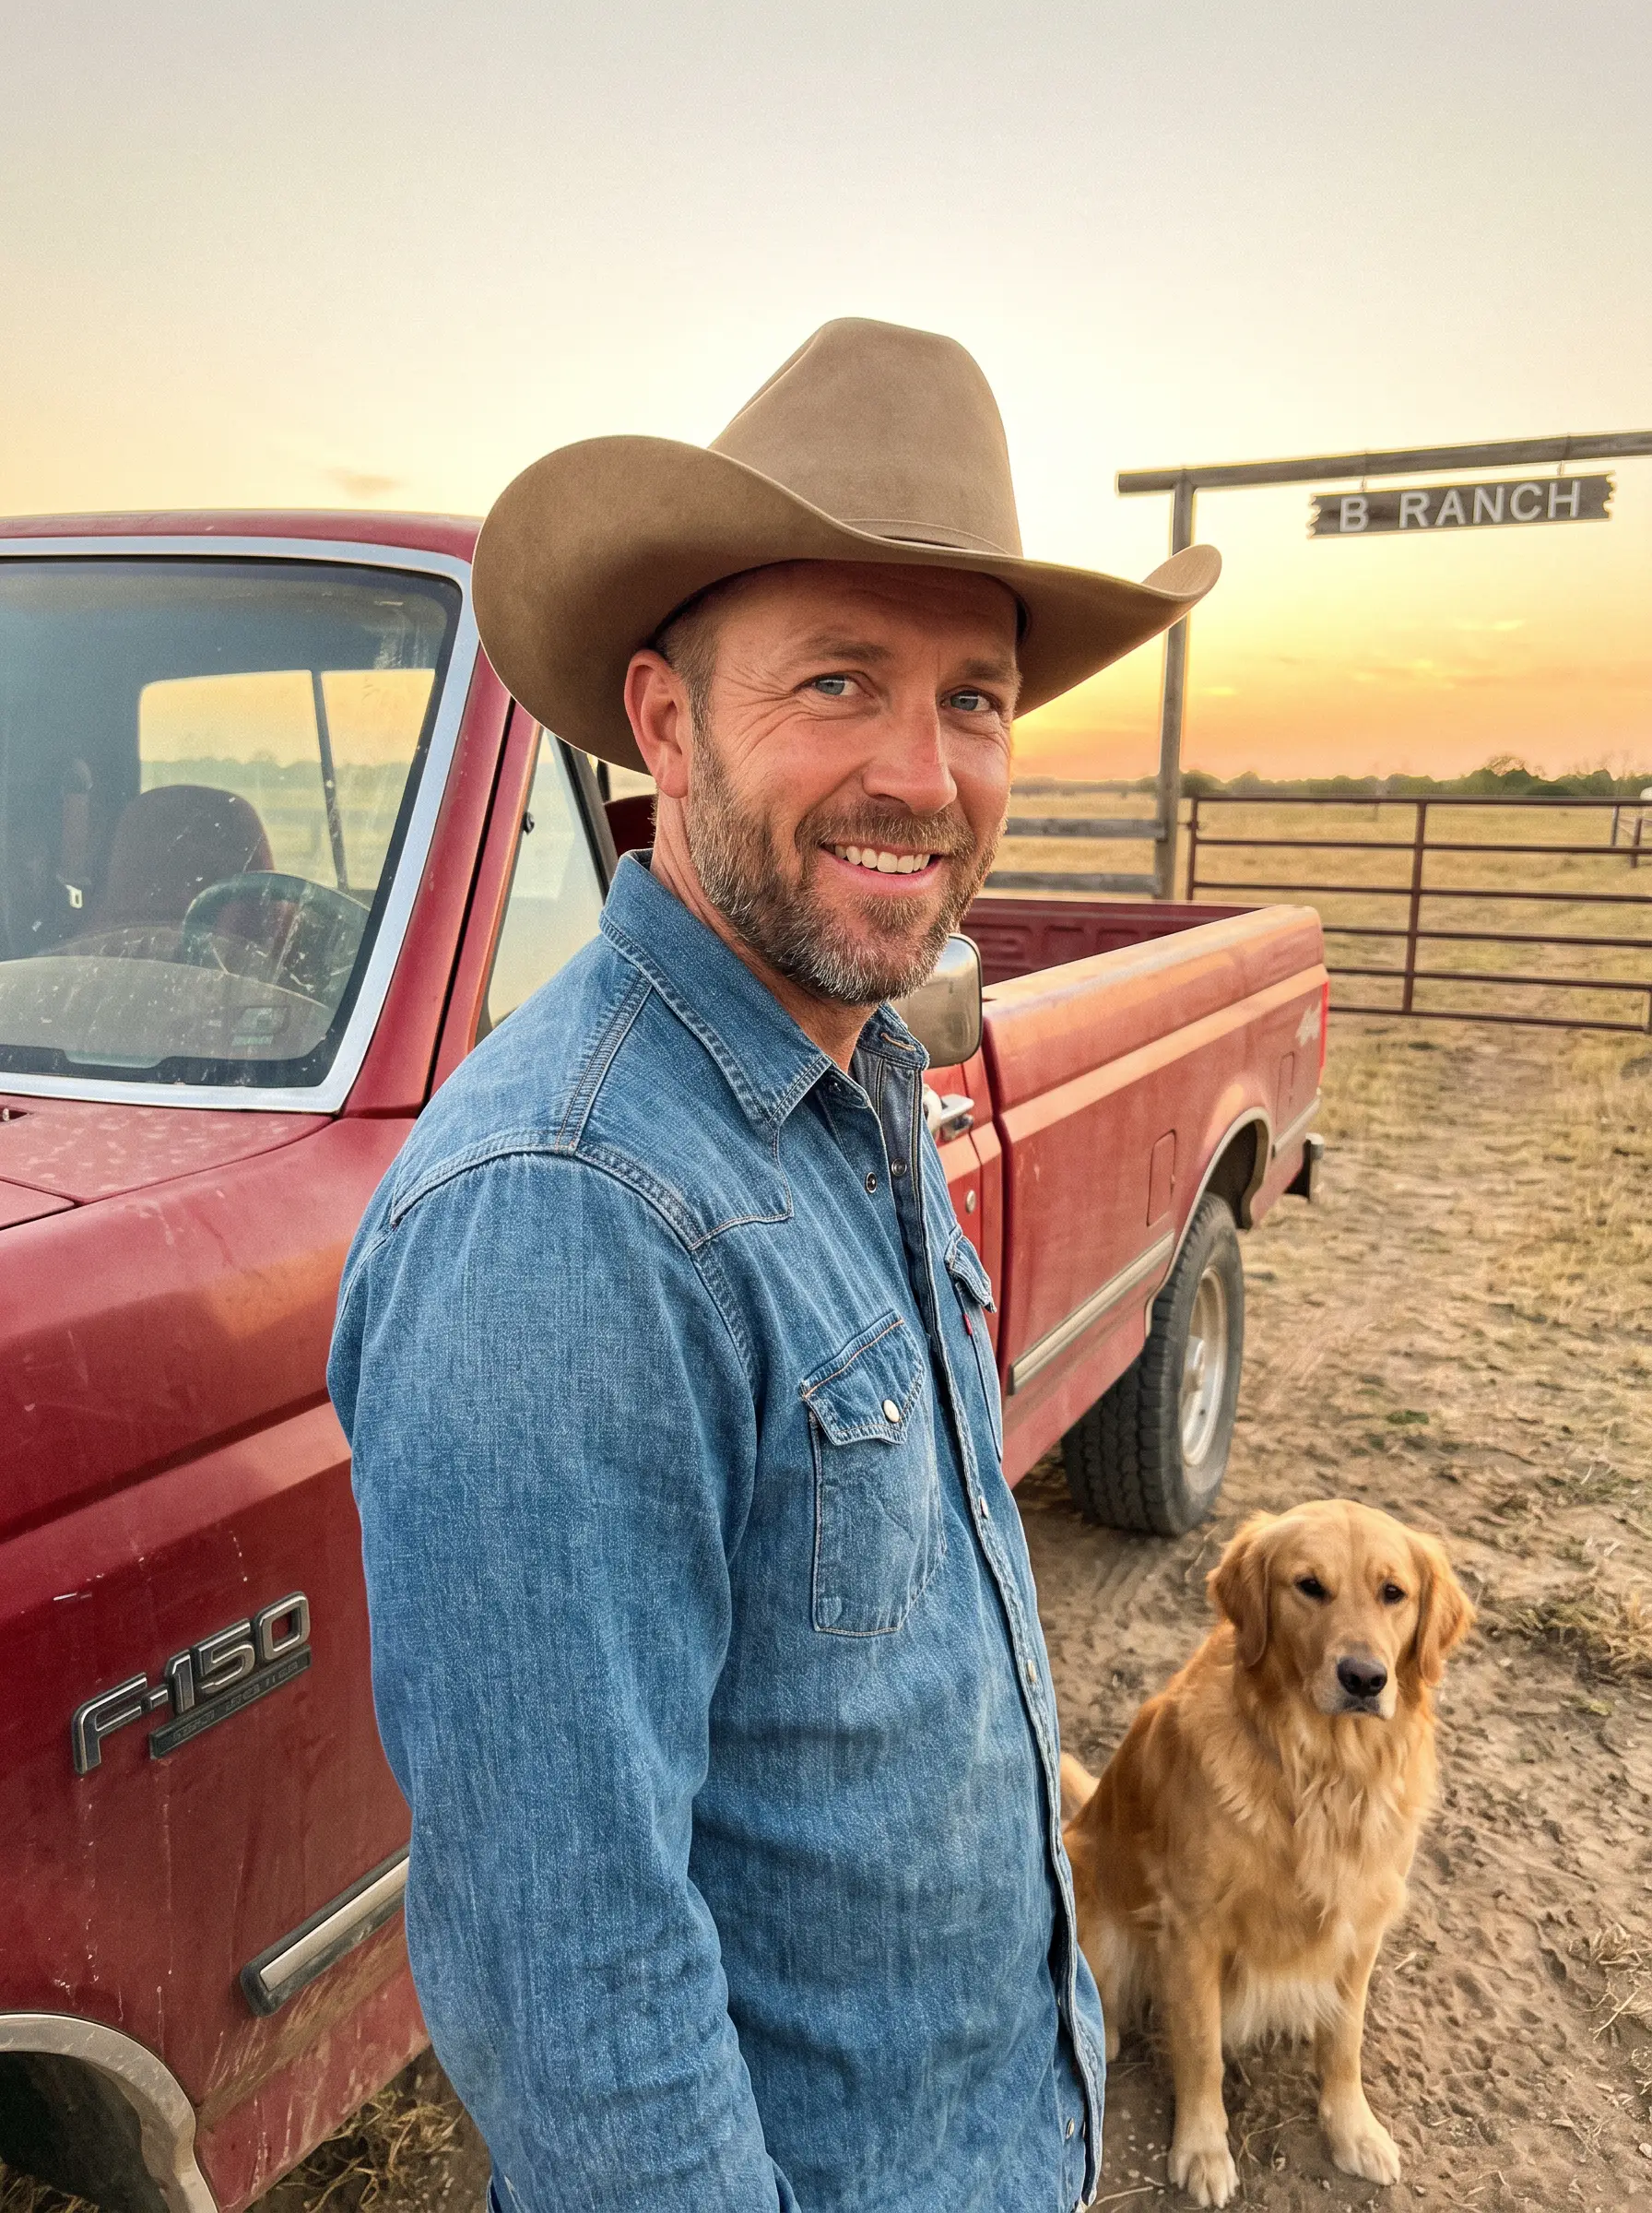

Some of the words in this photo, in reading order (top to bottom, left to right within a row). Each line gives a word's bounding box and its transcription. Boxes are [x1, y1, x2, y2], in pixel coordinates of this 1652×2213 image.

[1339, 494, 1370, 533] B
[1398, 479, 1581, 528] RANCH
[72, 1592, 311, 1776] F-150
